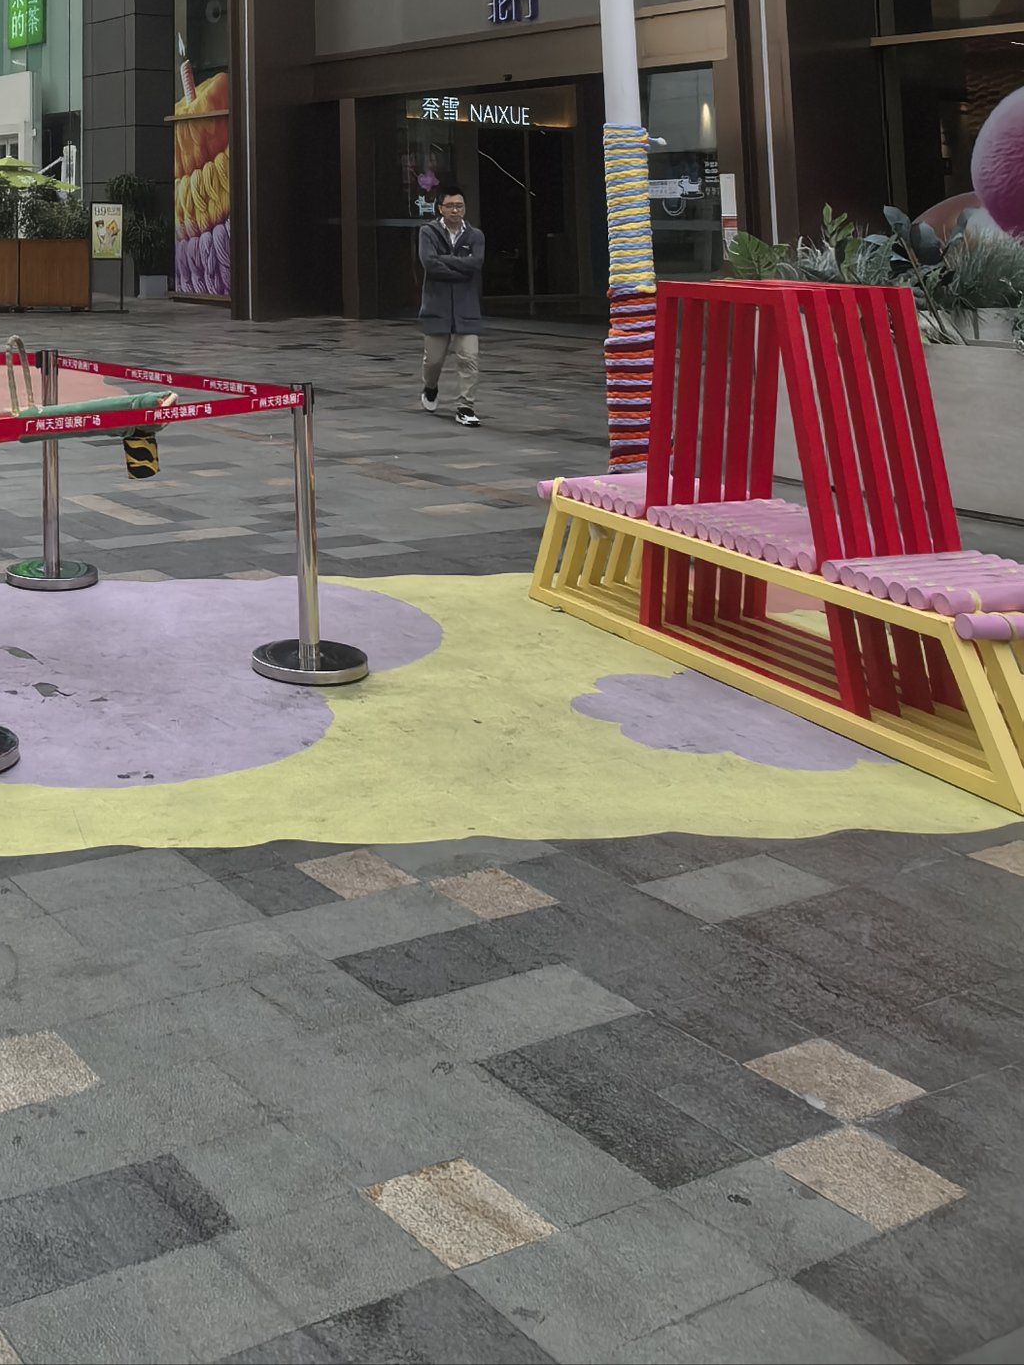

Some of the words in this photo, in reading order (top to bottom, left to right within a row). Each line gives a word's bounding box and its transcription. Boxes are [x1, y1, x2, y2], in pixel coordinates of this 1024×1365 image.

[422, 96, 460, 121] 奈雪
[470, 104, 530, 126] NAIXUE
[145, 403, 212, 421] 广州天河领展广场
[25, 414, 101, 432] 广州天河领展广场
